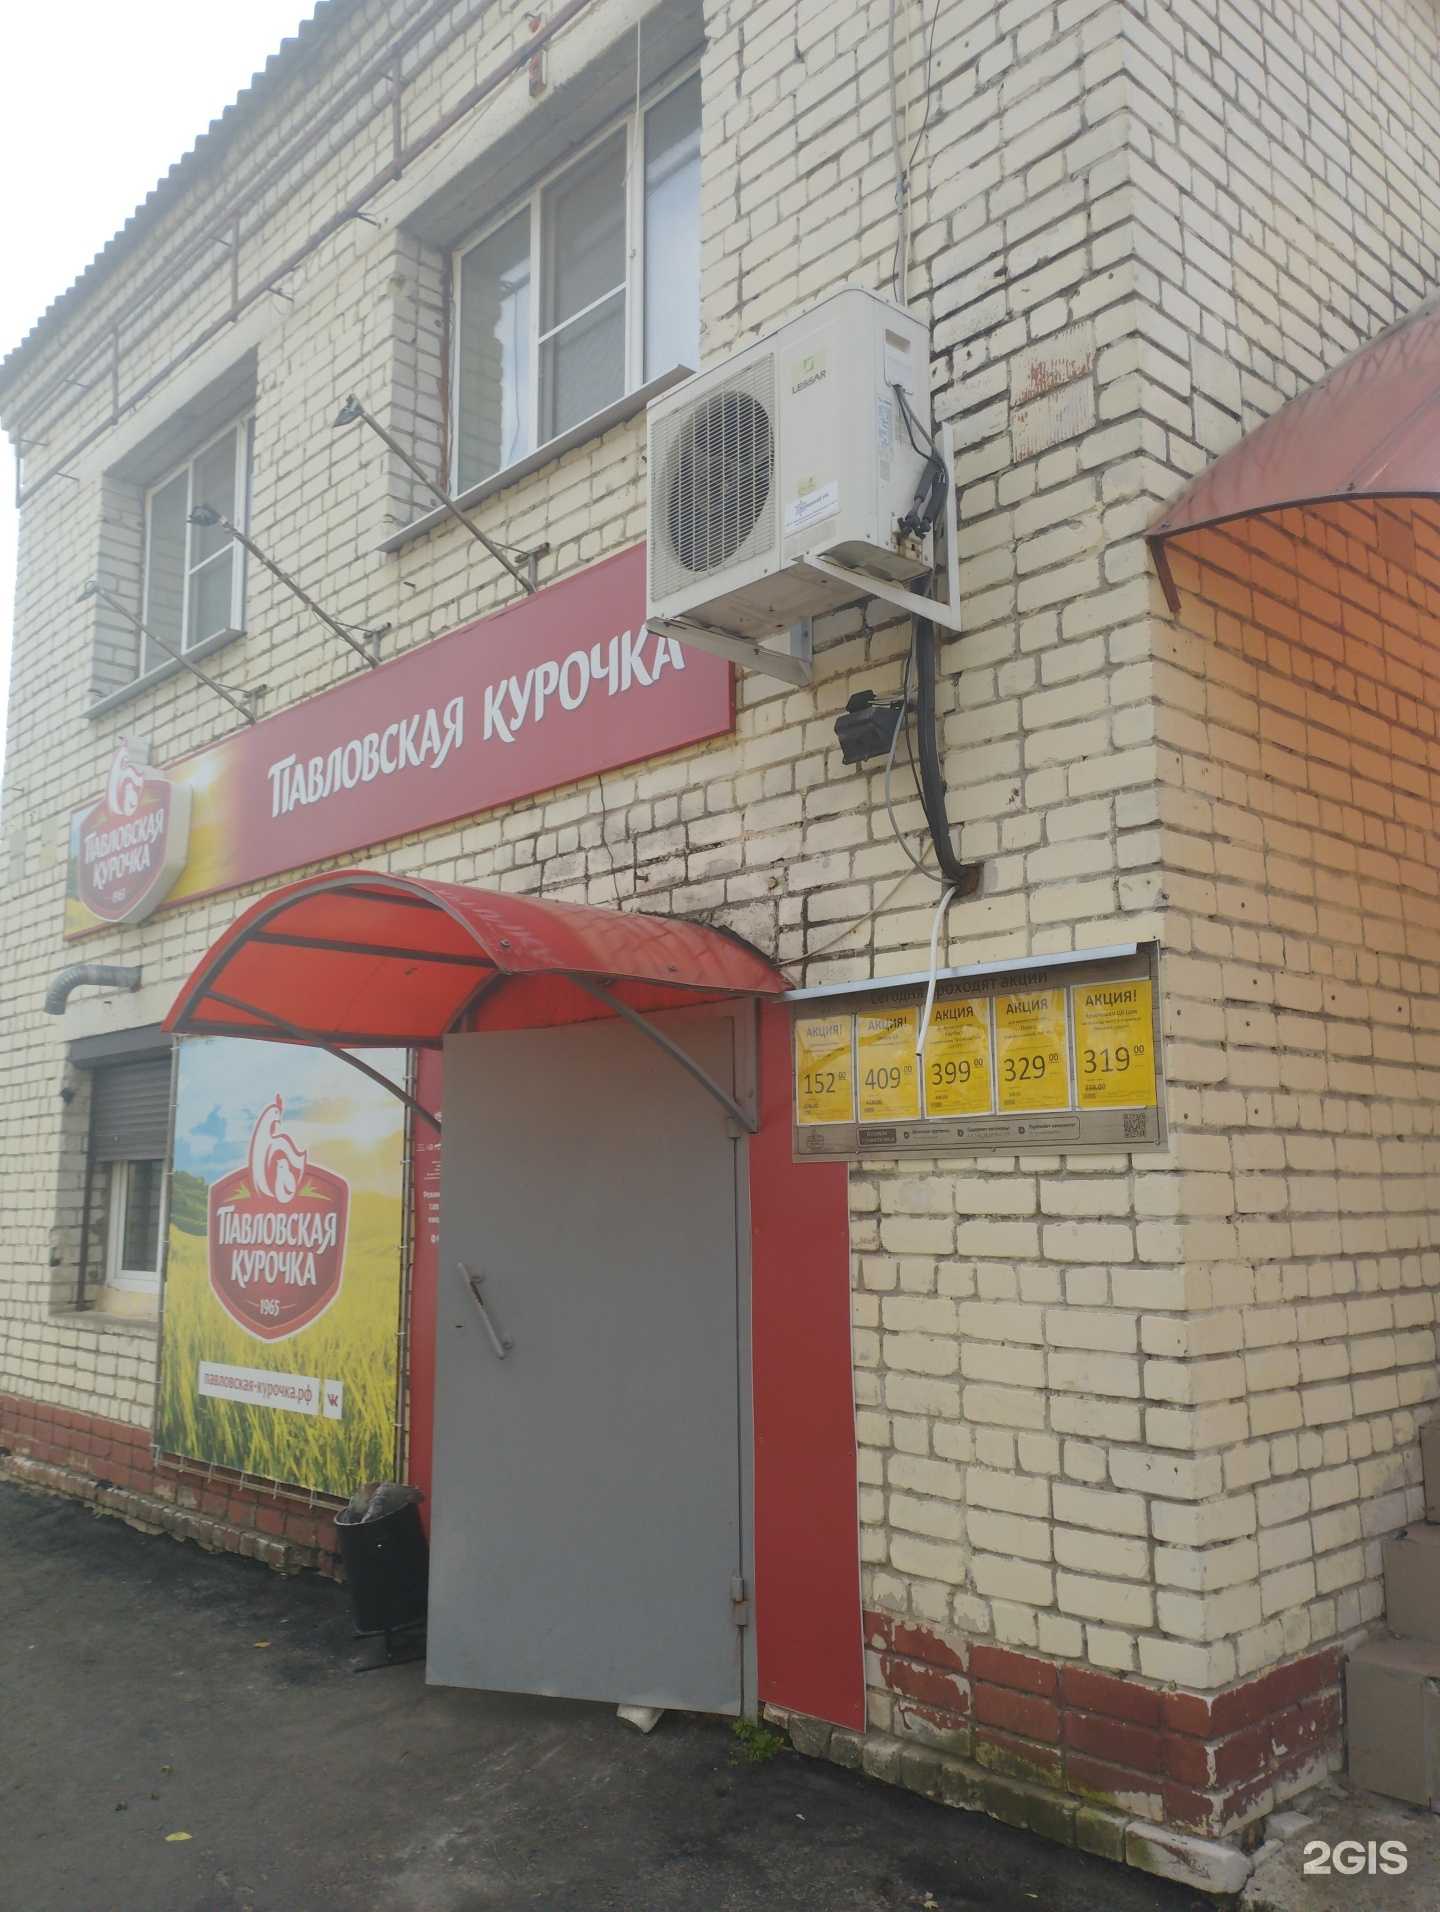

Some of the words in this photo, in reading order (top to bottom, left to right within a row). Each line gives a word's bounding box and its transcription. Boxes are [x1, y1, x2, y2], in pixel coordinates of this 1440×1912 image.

[931, 977, 998, 1000] роходят
[1085, 989, 1137, 1007] АКЦИЯ!
[1004, 1055, 1046, 1082] 329
[1083, 1046, 1130, 1074] 319
[803, 1072, 836, 1095] 152
[865, 1066, 901, 1090] 409
[931, 1060, 971, 1086] 399
[259, 1298, 280, 1317] 1965
[204, 1372, 313, 1406] павловская-курочка.рф
